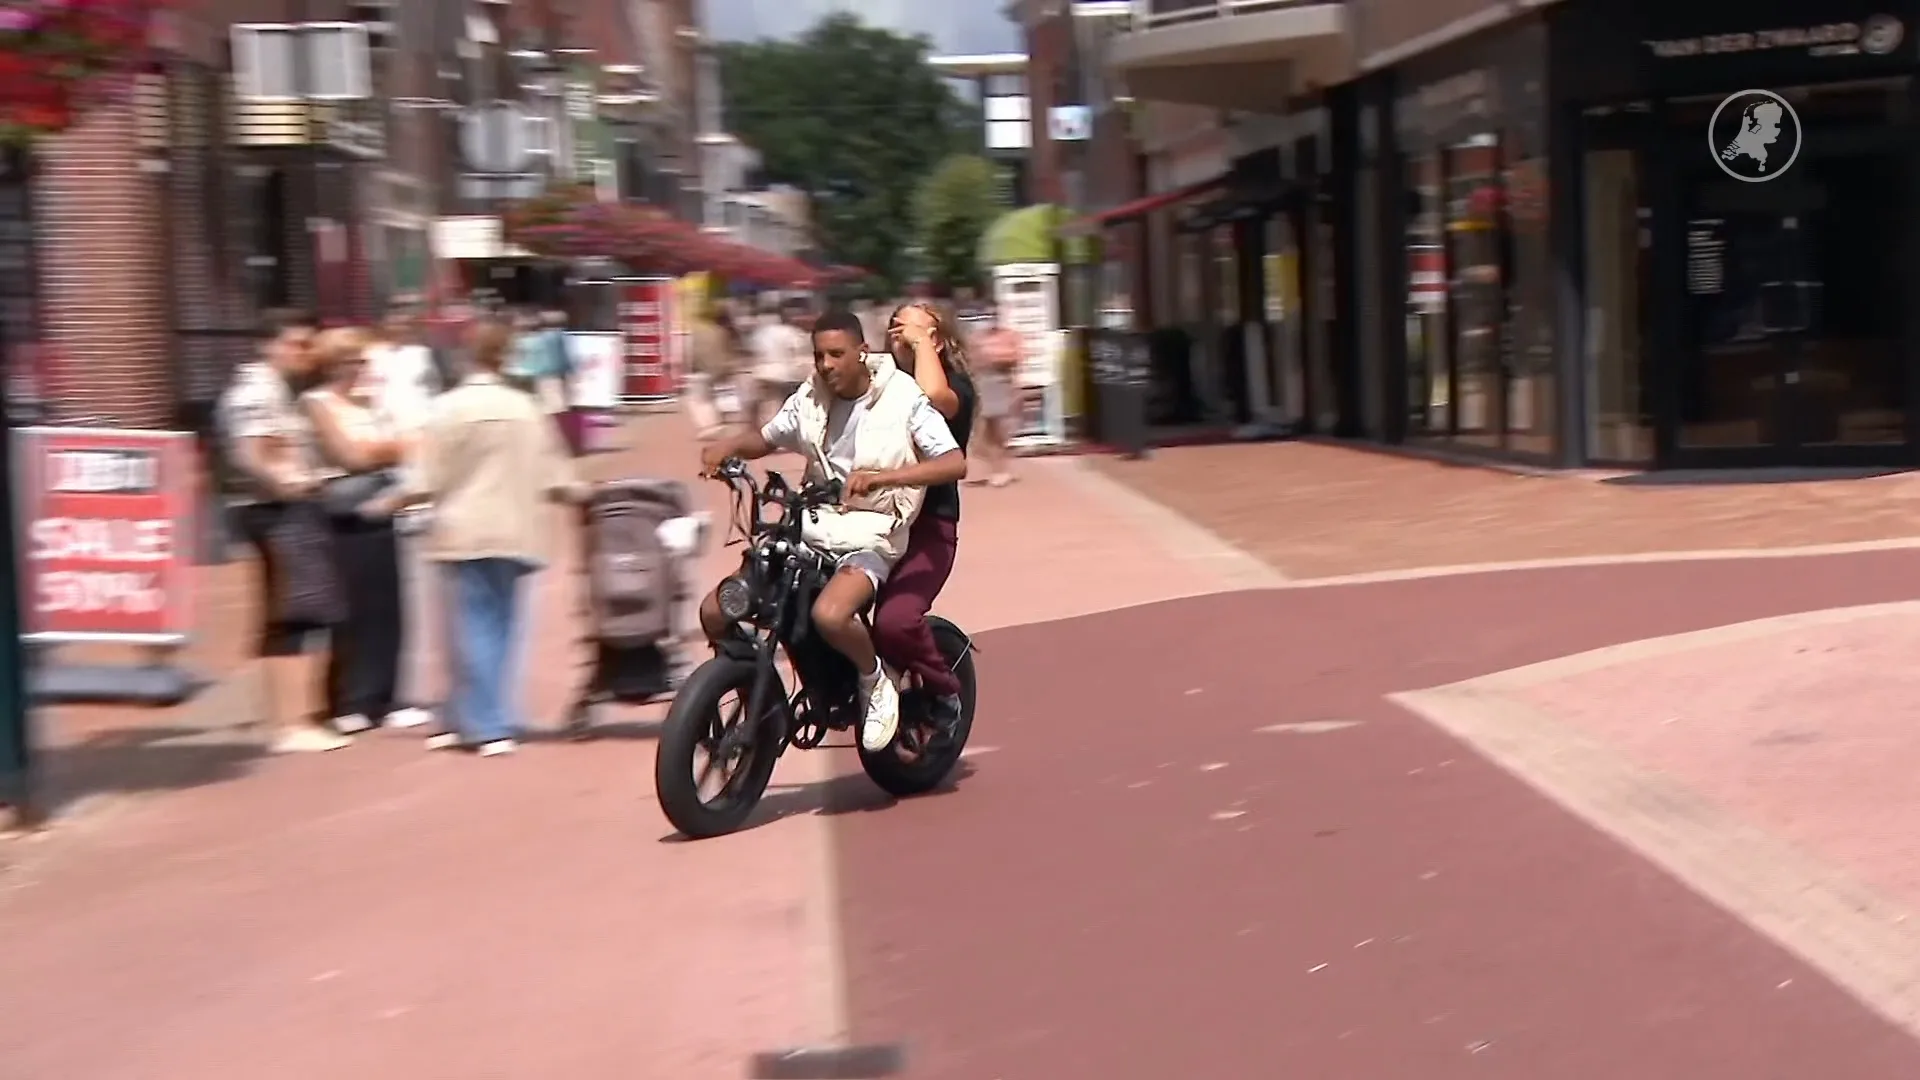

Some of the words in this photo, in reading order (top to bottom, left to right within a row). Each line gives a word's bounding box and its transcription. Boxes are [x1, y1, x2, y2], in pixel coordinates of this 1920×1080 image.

[1641, 39, 1702, 57] VAN
[1703, 33, 1755, 54] DER
[1756, 22, 1860, 48] ZWAARD
[30, 517, 174, 560] SALE
